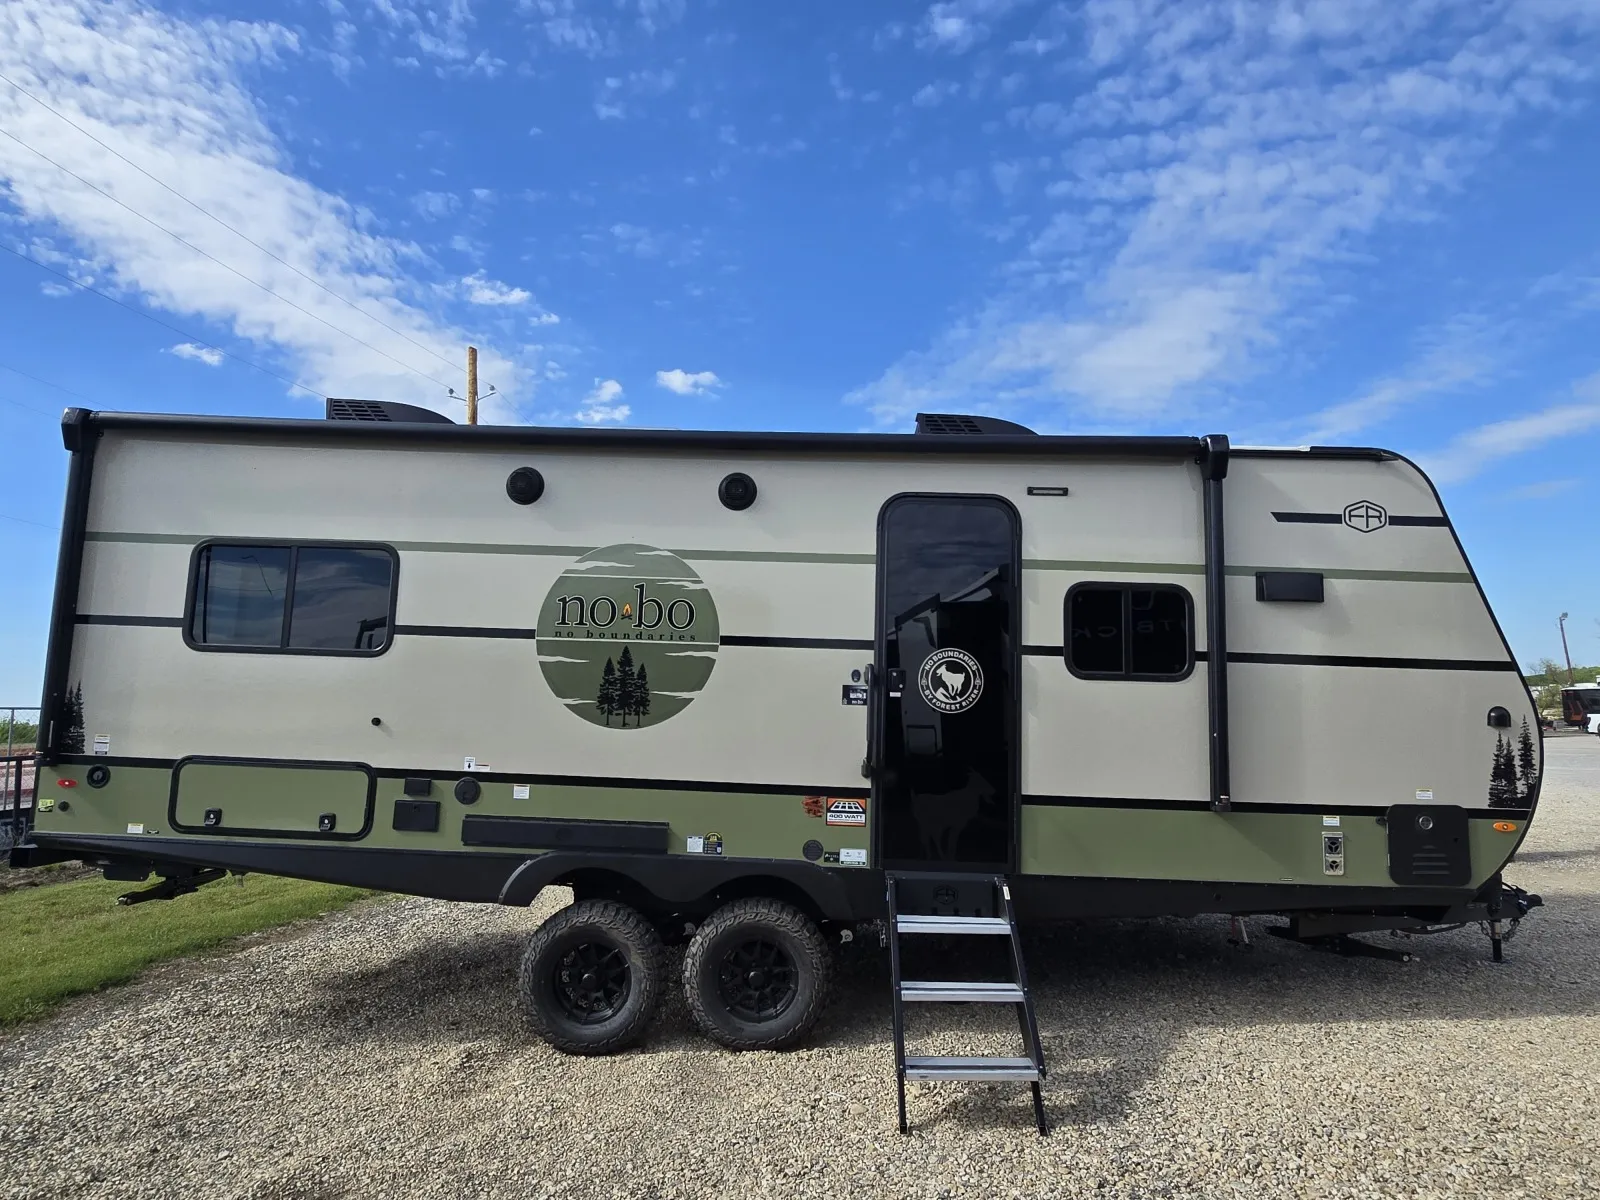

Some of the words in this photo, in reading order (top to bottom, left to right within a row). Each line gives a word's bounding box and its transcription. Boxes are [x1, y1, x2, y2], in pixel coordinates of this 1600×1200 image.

[554, 629, 574, 638] no
[587, 629, 696, 641] boundaries
[924, 659, 934, 671] NO
[931, 650, 978, 671] BOUNDARIES
[924, 689, 934, 699] BY
[931, 698, 961, 710] FOREST
[961, 689, 979, 707] RIVER
